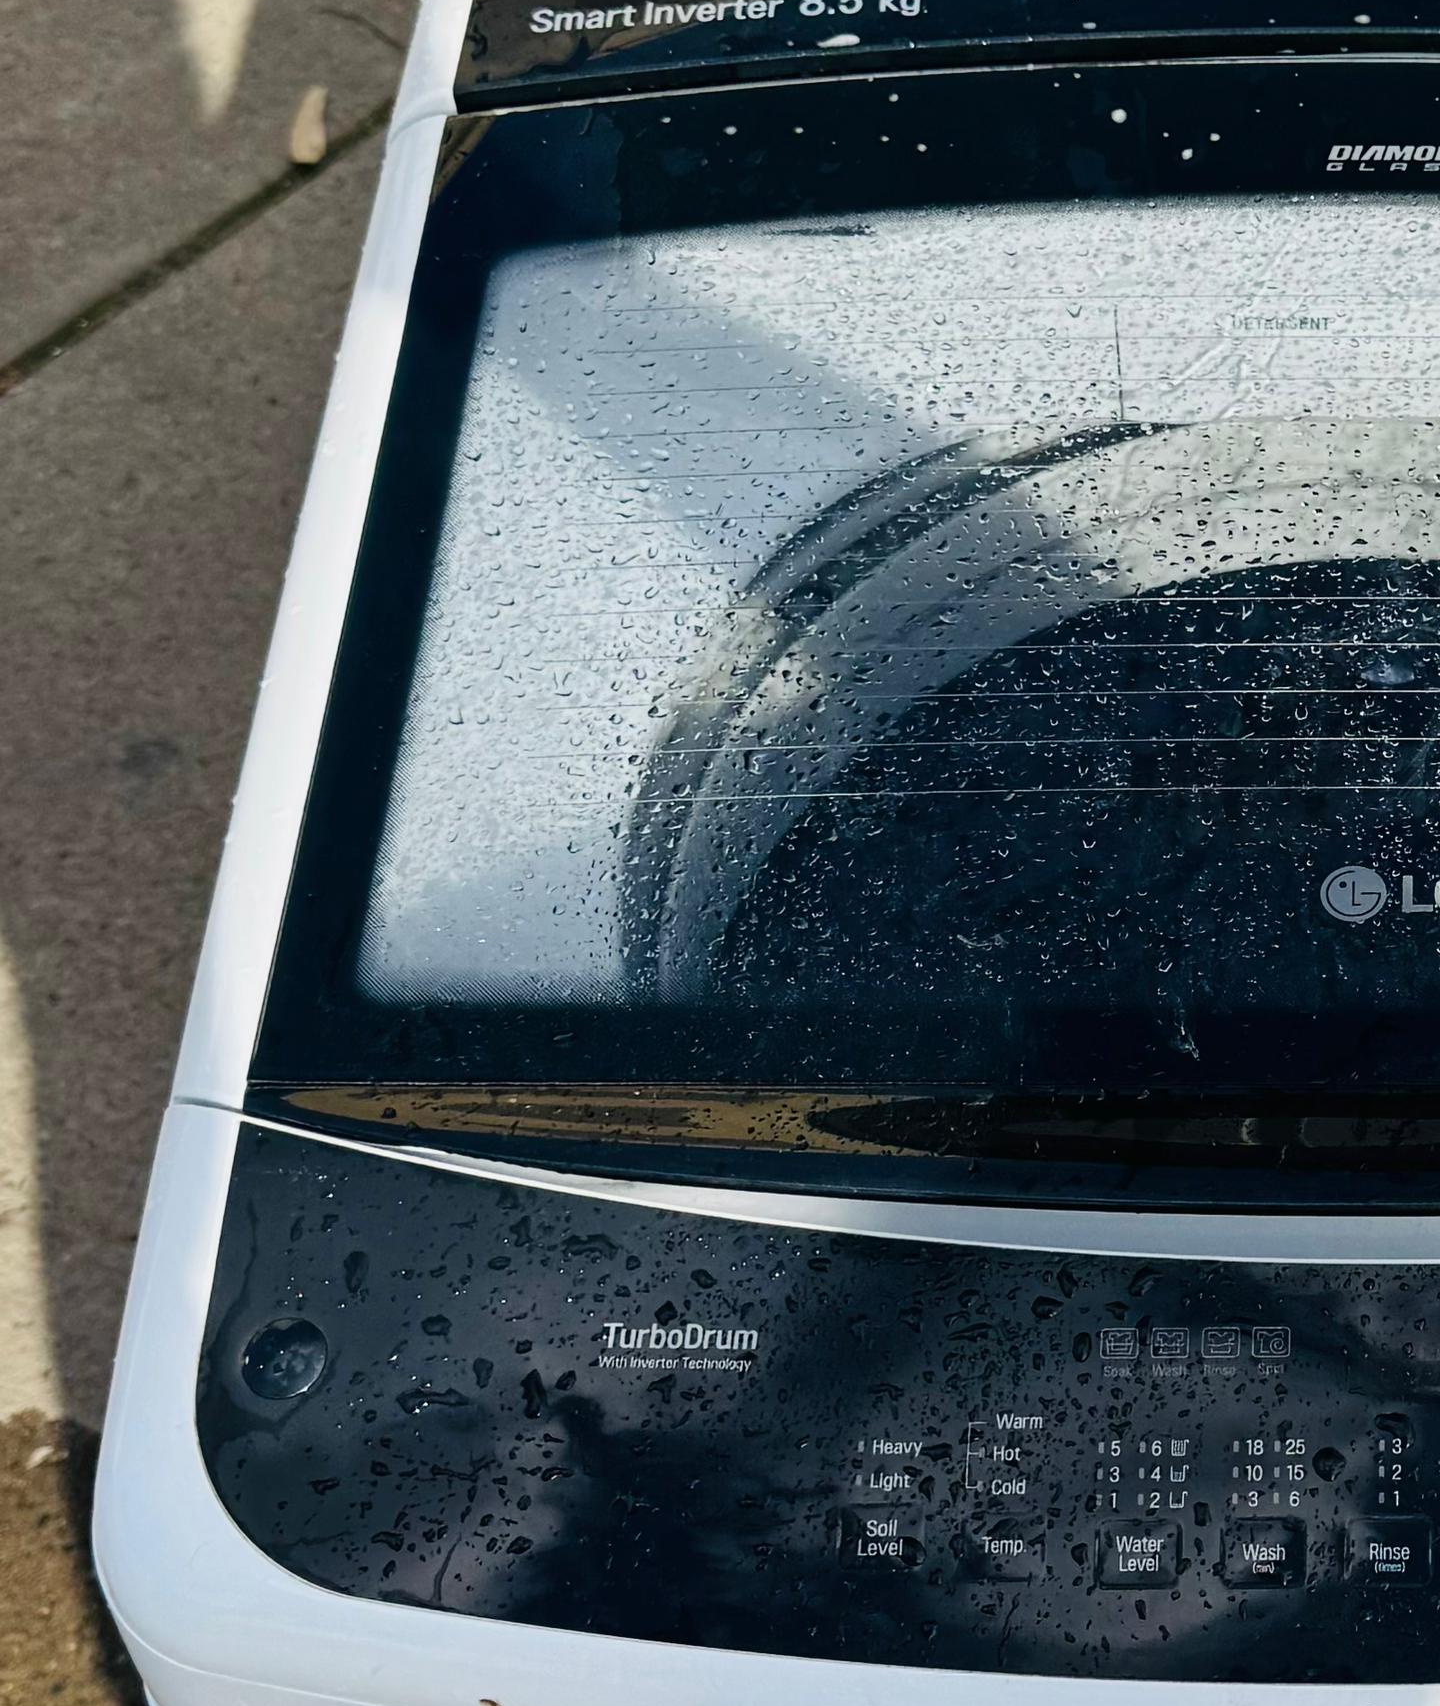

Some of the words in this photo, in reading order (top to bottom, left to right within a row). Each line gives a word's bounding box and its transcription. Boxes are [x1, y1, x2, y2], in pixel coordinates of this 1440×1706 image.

[530, 4, 635, 34] Smart
[603, 1323, 758, 1350] TurboDrum
[599, 1356, 627, 1368] With
[630, 1356, 678, 1369] Inverter
[682, 1357, 751, 1372] Technology
[996, 1413, 1043, 1430] Warm
[872, 1439, 922, 1457] Heavy
[993, 1446, 1021, 1461] Hot
[1110, 1440, 1121, 1456] 5
[1151, 1440, 1162, 1456] 6
[1246, 1439, 1264, 1455] 18
[1285, 1439, 1306, 1455] 25
[1391, 1438, 1402, 1454] 3
[1109, 1467, 1120, 1483] 3
[1150, 1466, 1161, 1482] 4
[1246, 1465, 1263, 1481] 10
[1286, 1465, 1305, 1481] 15
[1391, 1464, 1402, 1480] 2
[870, 1473, 911, 1491] Light
[991, 1479, 1026, 1495] Cold
[1110, 1492, 1118, 1508] 1
[1150, 1492, 1161, 1508] 2
[1248, 1491, 1258, 1507] 3
[1289, 1491, 1300, 1507] 6
[1393, 1490, 1400, 1506] 1
[866, 1520, 898, 1537] Soil
[857, 1539, 903, 1556] Level
[1116, 1535, 1164, 1552] Water
[1369, 1542, 1410, 1560] Rinse
[1242, 1544, 1286, 1561] Wash
[1119, 1554, 1158, 1572] Level
